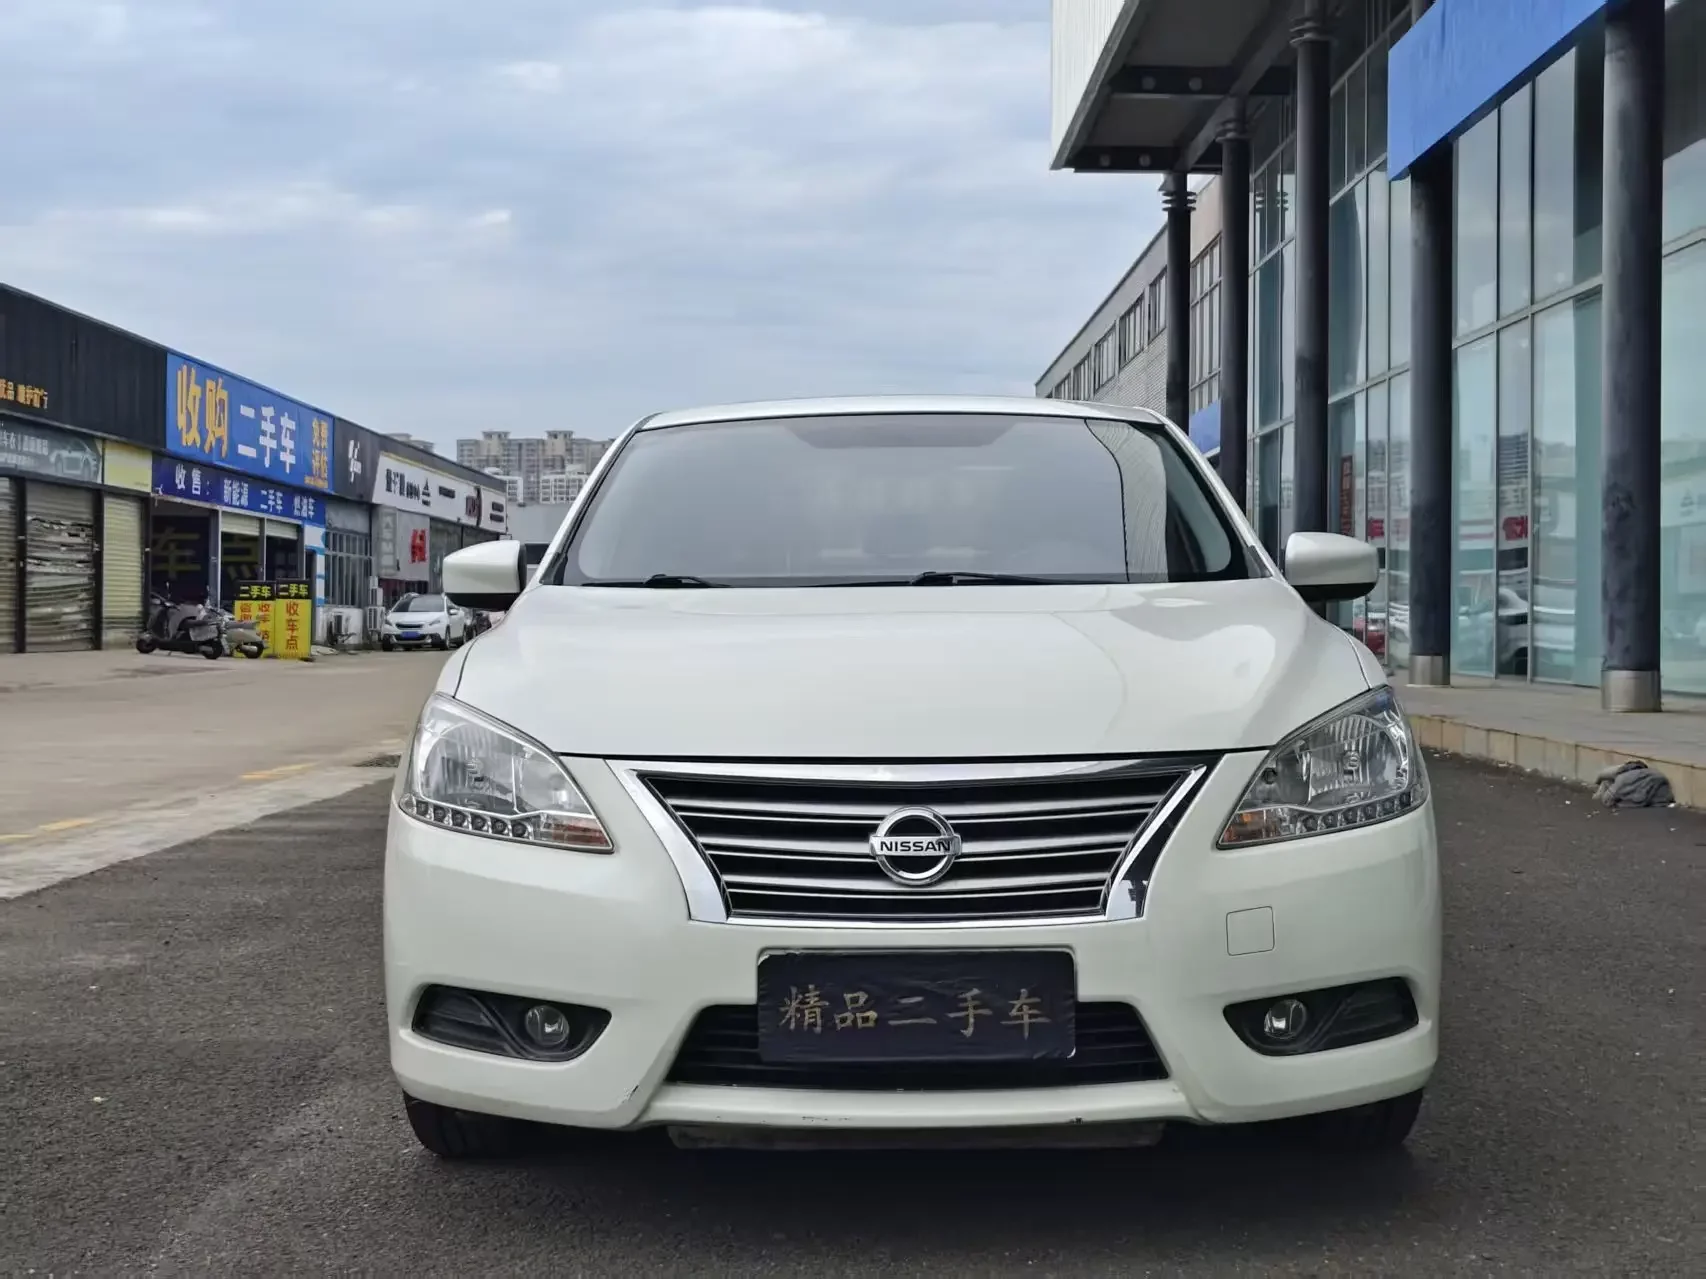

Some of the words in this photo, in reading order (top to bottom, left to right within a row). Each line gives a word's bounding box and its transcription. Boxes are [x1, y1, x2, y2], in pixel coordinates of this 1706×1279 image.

[177, 364, 229, 459] 收购
[237, 406, 297, 474] 二手车
[223, 478, 249, 507] 新能源
[260, 489, 283, 513] 二手车
[294, 496, 315, 519] 燃油车
[239, 585, 272, 598] 二手车
[278, 584, 309, 597] 二手车
[286, 601, 301, 650] 收车点
[880, 840, 951, 852] NISSAN
[778, 983, 1051, 1040] 精品二手车
